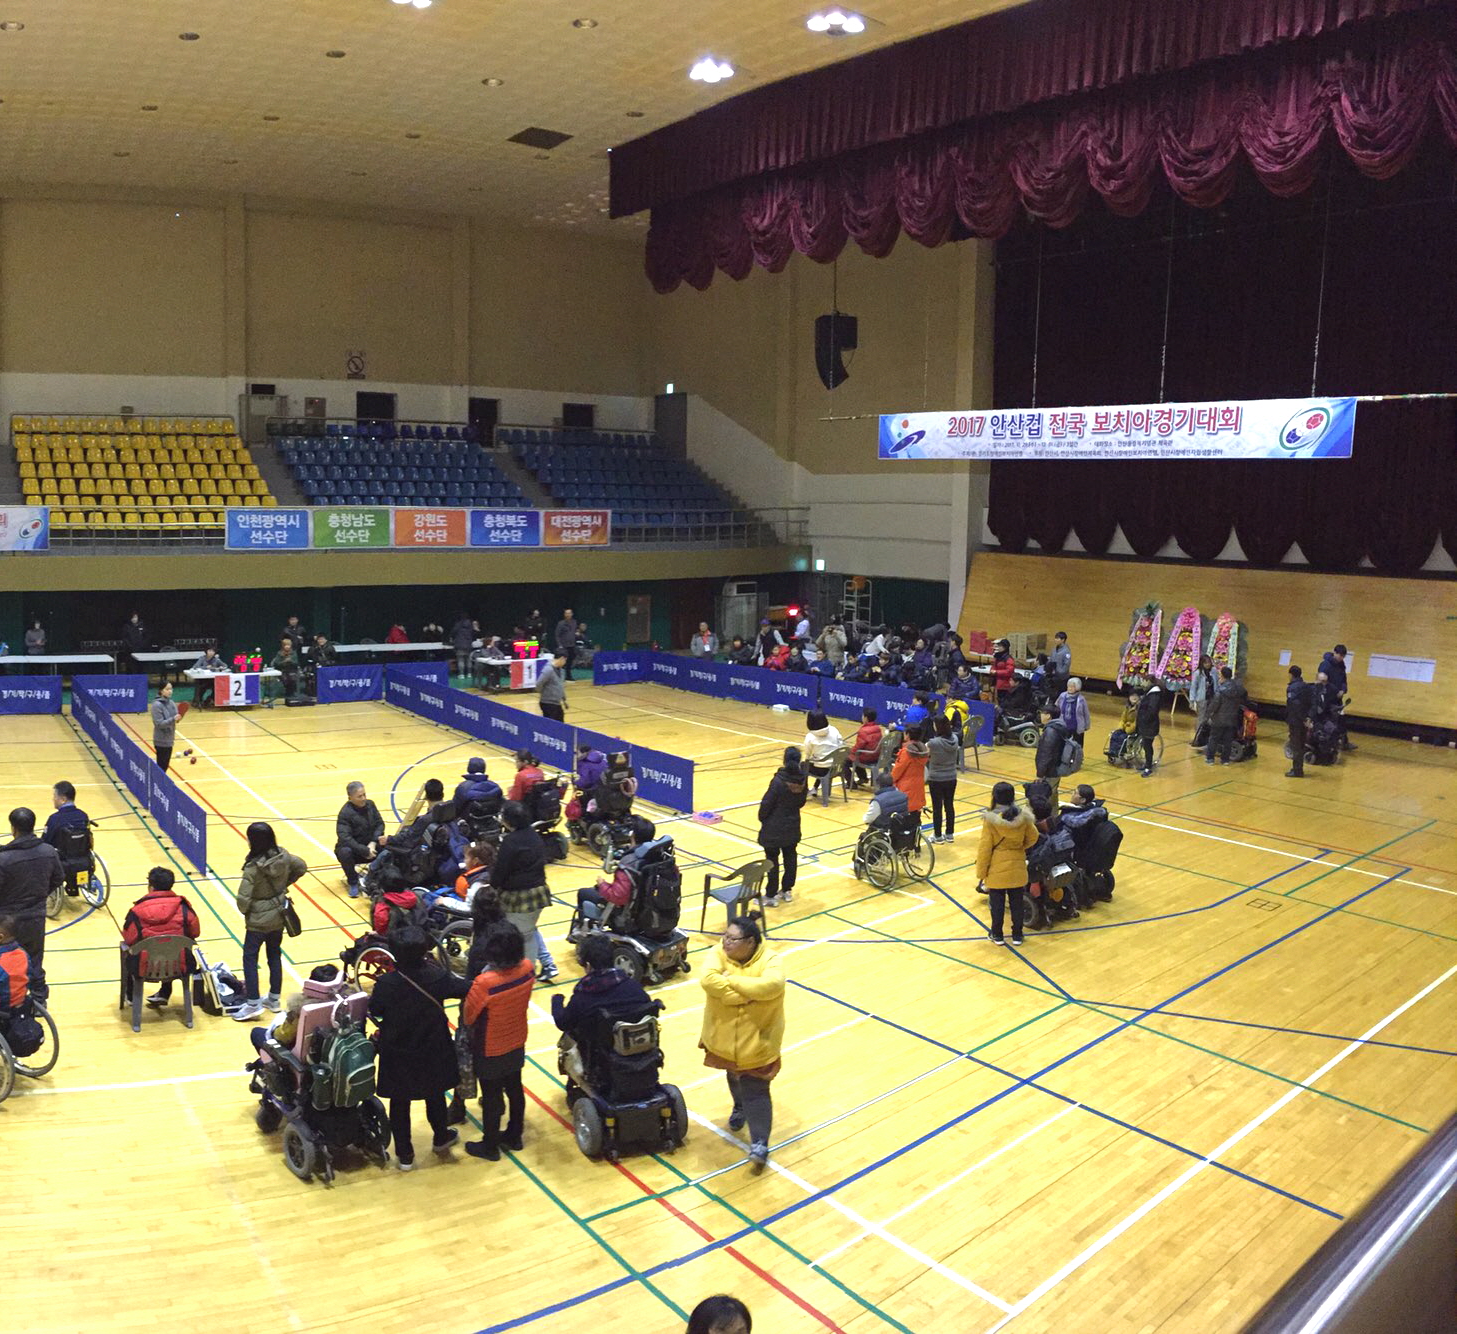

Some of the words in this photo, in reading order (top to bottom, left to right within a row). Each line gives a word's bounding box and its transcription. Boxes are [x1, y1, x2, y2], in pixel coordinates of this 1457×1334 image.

[947, 416, 986, 437] 2017
[990, 412, 1043, 439] 안산컵
[1049, 412, 1086, 438] 전국
[1091, 405, 1242, 436] 보치아경기대회
[236, 514, 300, 528] 인천광역시
[328, 514, 376, 528] 충청남도
[414, 514, 448, 527] 강원도
[483, 514, 528, 528] 충청북도
[551, 515, 602, 528] 대전광역시
[250, 530, 288, 544] 선수단
[334, 530, 370, 543] 선수단
[413, 529, 448, 543] 선수단
[488, 530, 523, 543] 선수단
[559, 530, 592, 543] 선수단
[527, 664, 533, 679] 1
[233, 680, 242, 696] 2
